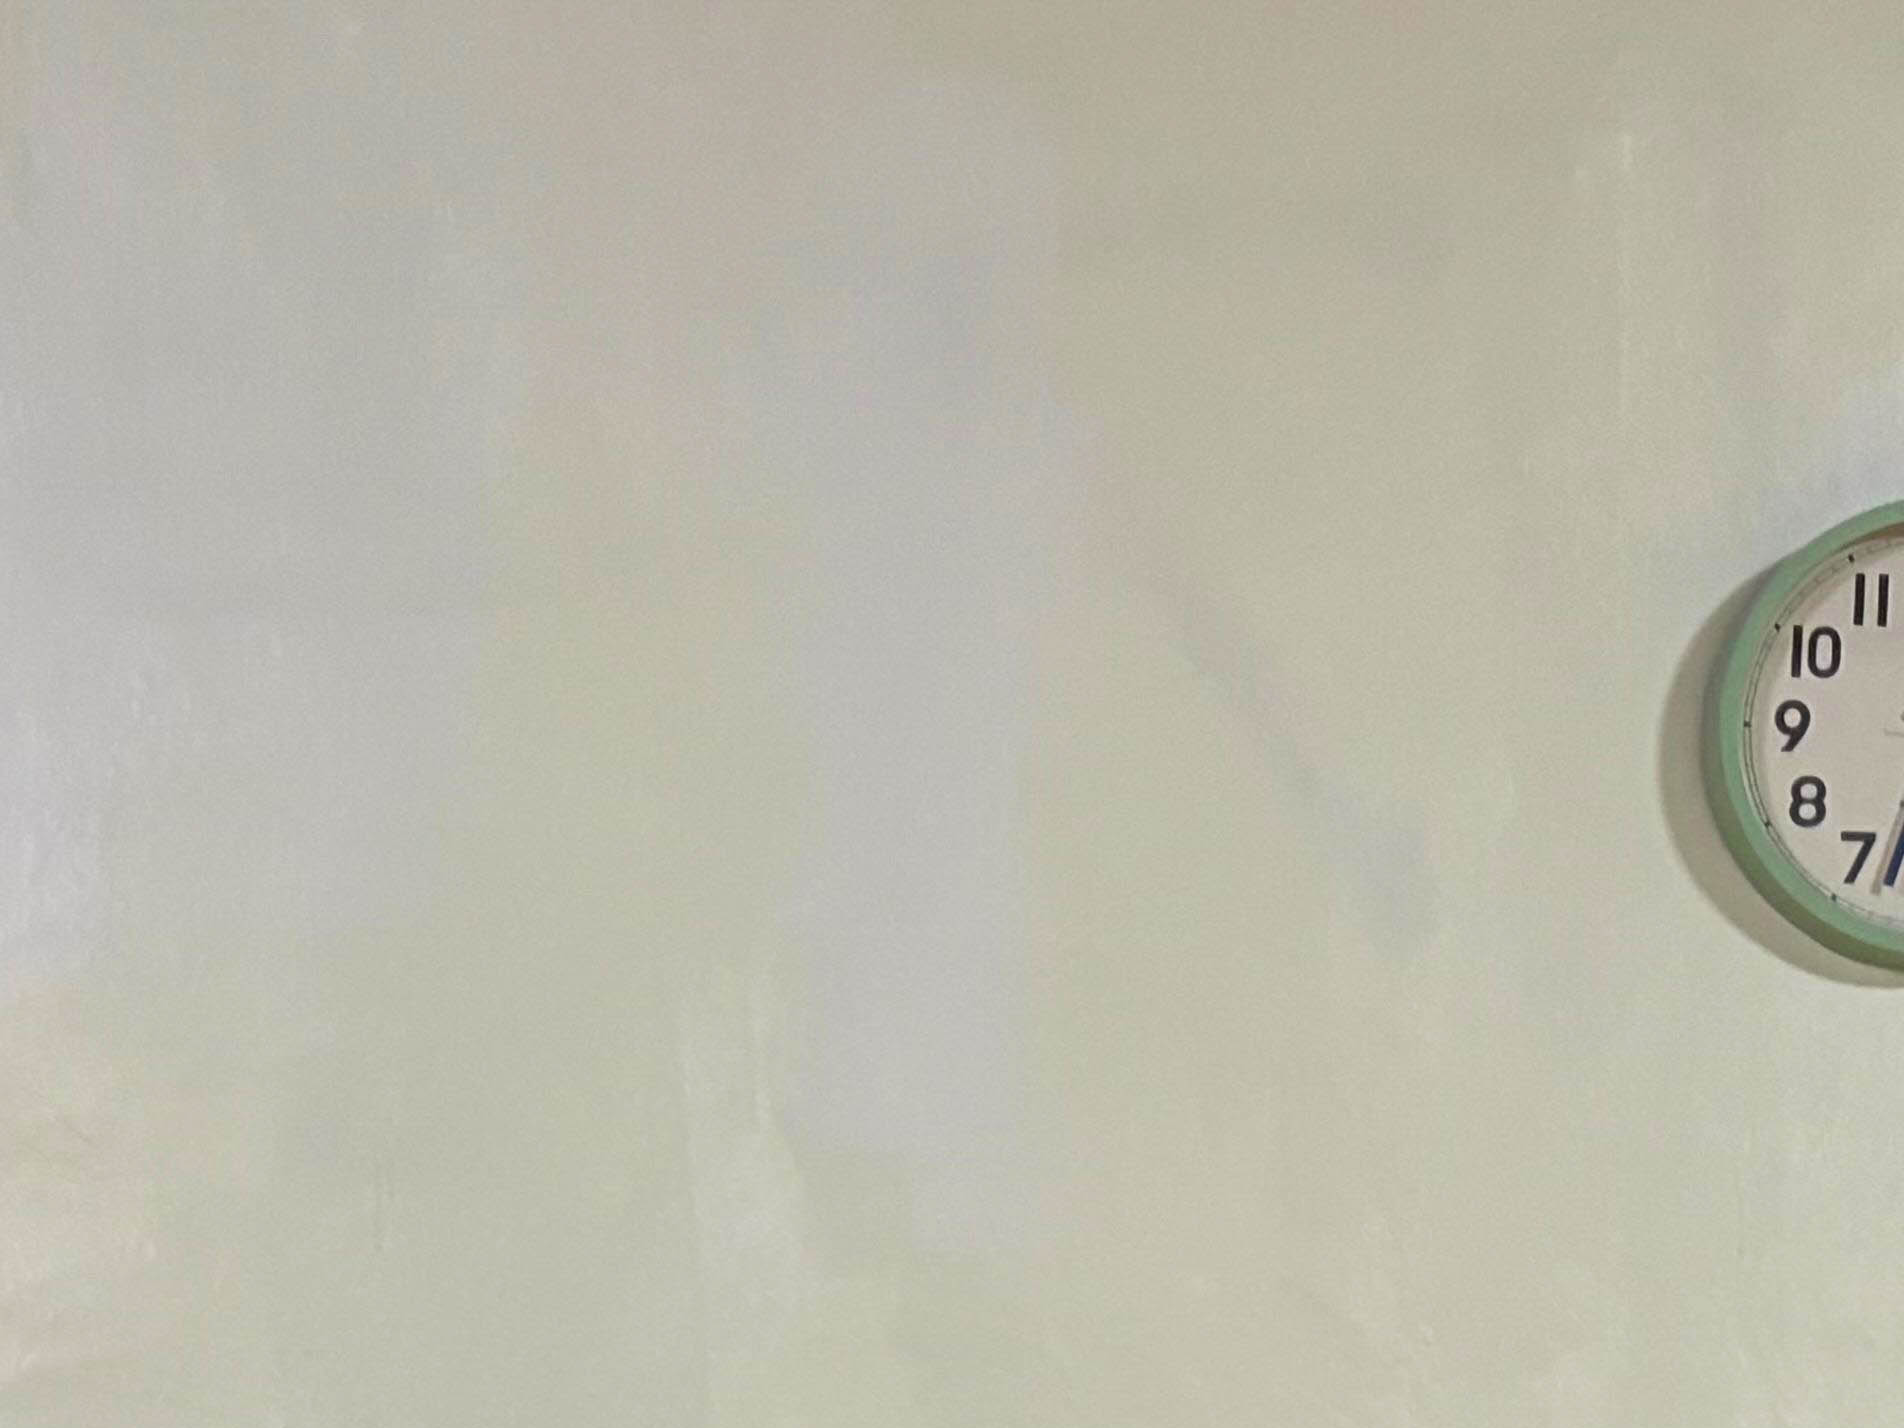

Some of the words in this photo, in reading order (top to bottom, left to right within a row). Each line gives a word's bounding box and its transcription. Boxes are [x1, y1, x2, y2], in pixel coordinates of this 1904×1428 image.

[1853, 573, 1889, 627] 11
[1790, 625, 1842, 678] 10
[1775, 700, 1811, 752] 9
[1790, 776, 1827, 828] 8
[1840, 832, 1876, 884] 7
